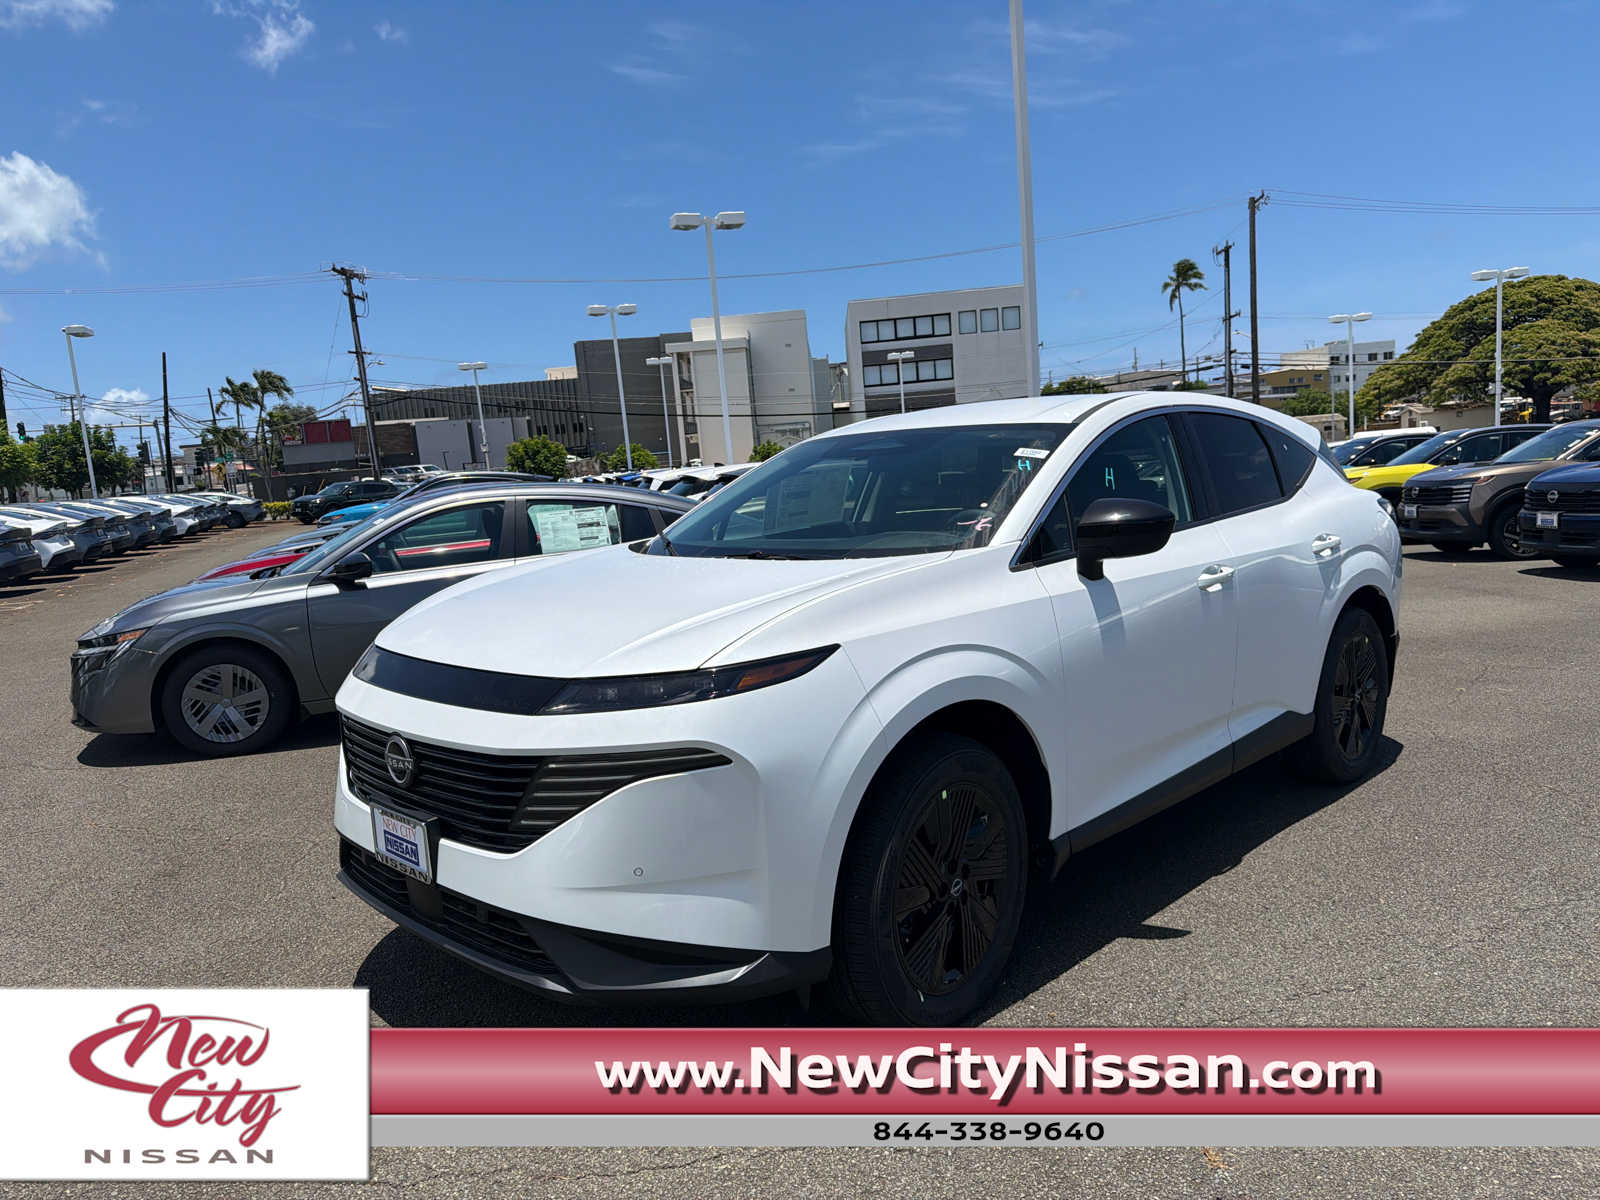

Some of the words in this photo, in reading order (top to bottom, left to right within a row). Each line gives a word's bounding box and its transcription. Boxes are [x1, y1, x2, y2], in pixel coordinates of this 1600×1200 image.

[1105, 467, 1115, 490] H
[400, 823, 417, 841] CITY
[385, 834, 418, 861] NISSAN
[376, 853, 429, 883] NISSAN
